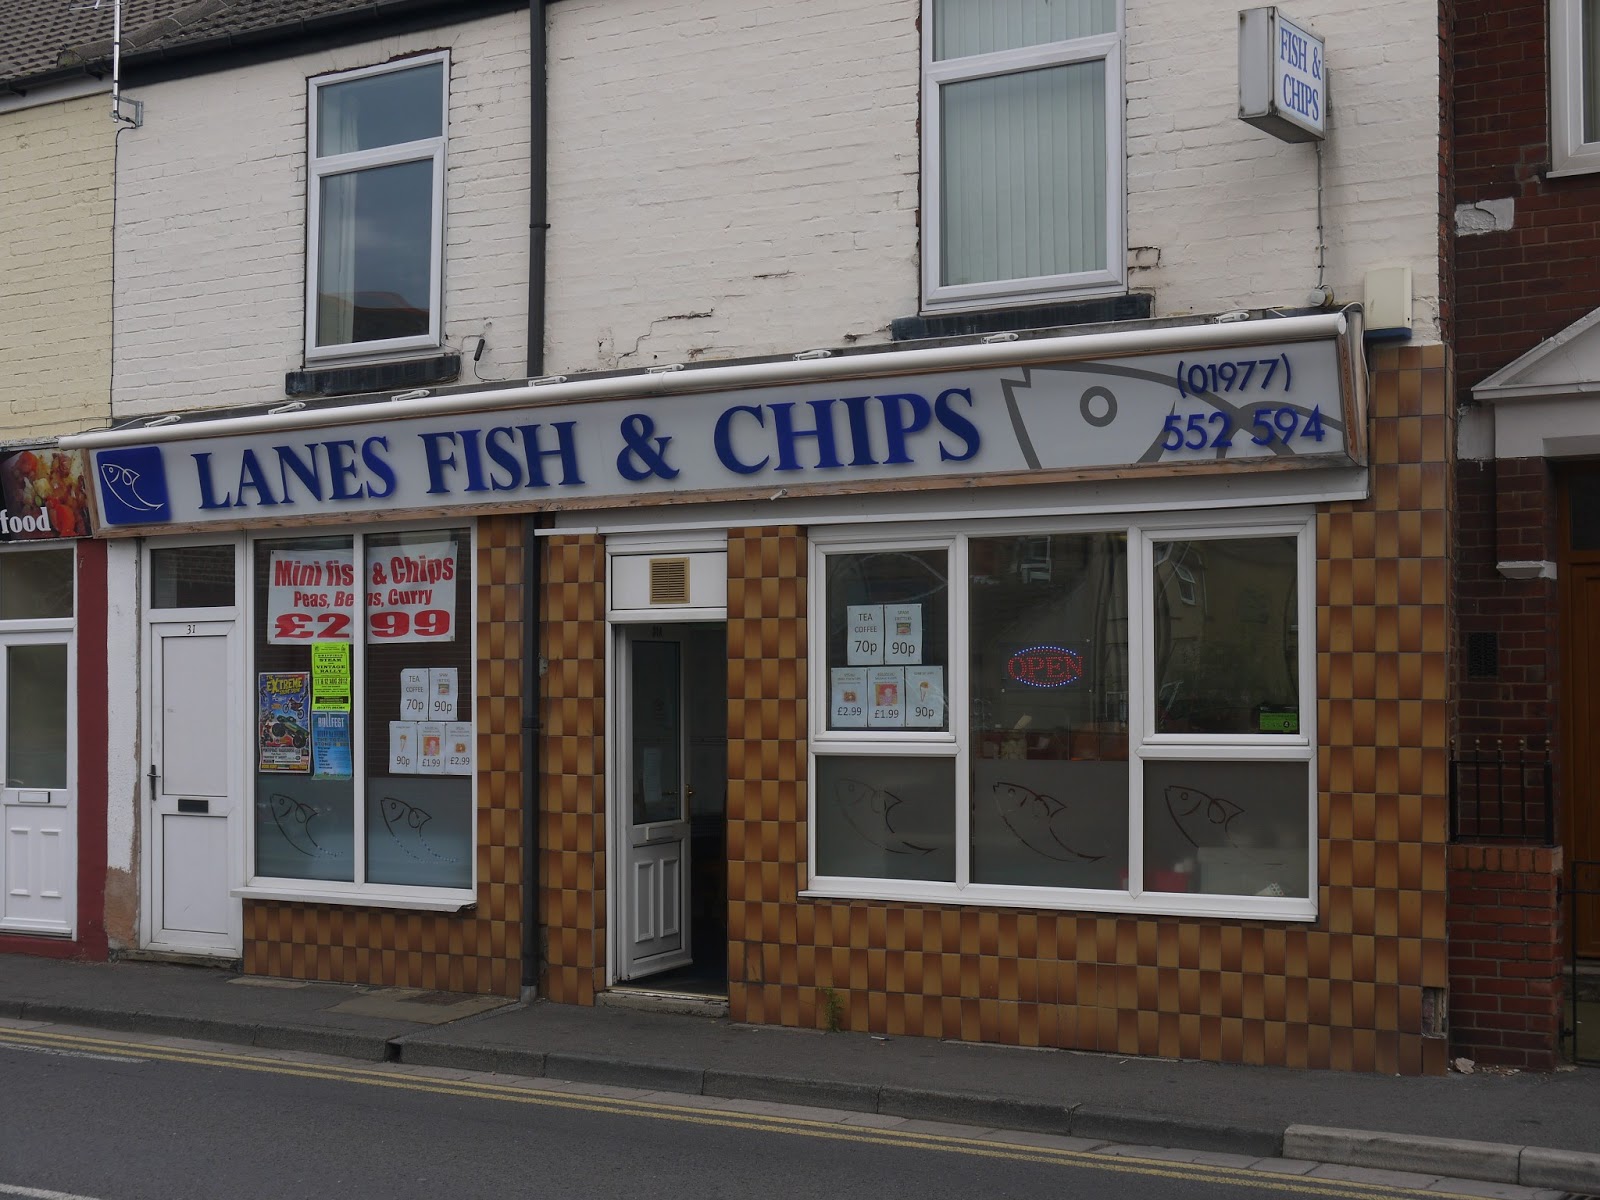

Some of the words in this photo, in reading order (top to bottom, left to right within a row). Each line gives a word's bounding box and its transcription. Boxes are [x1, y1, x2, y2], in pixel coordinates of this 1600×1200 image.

[1280, 27, 1308, 73] FISH
[1312, 46, 1321, 81] &
[1283, 73, 1319, 121] CHIPS
[1177, 352, 1292, 399] (01977)
[1161, 411, 1233, 452] 552
[1250, 403, 1326, 447] 594
[190, 435, 397, 510] LANES
[417, 420, 586, 495] FISH
[616, 413, 680, 482] &
[713, 387, 981, 475] CHIPS
[0, 506, 51, 534] food
[274, 559, 323, 586] Mini
[325, 559, 354, 586] fis
[372, 561, 388, 586] &
[389, 552, 454, 585] Chips
[293, 590, 331, 608] Peas,
[333, 590, 385, 608] Bens,
[387, 588, 433, 606] Curry
[858, 613, 873, 621] TEA
[185, 624, 196, 635] 31
[854, 640, 877, 655] 70p
[892, 641, 915, 657] 90p
[1007, 656, 1083, 679] OPEN
[266, 677, 303, 694] EXTREME
[408, 675, 420, 683] TEA
[406, 698, 424, 712] 70p
[434, 700, 453, 714] 90p
[837, 706, 862, 717] £2.99
[915, 706, 935, 719] 90p
[874, 709, 899, 719] £1.99
[396, 756, 410, 767] 90p
[422, 758, 440, 767] £1.99
[450, 757, 470, 765] £2.99
